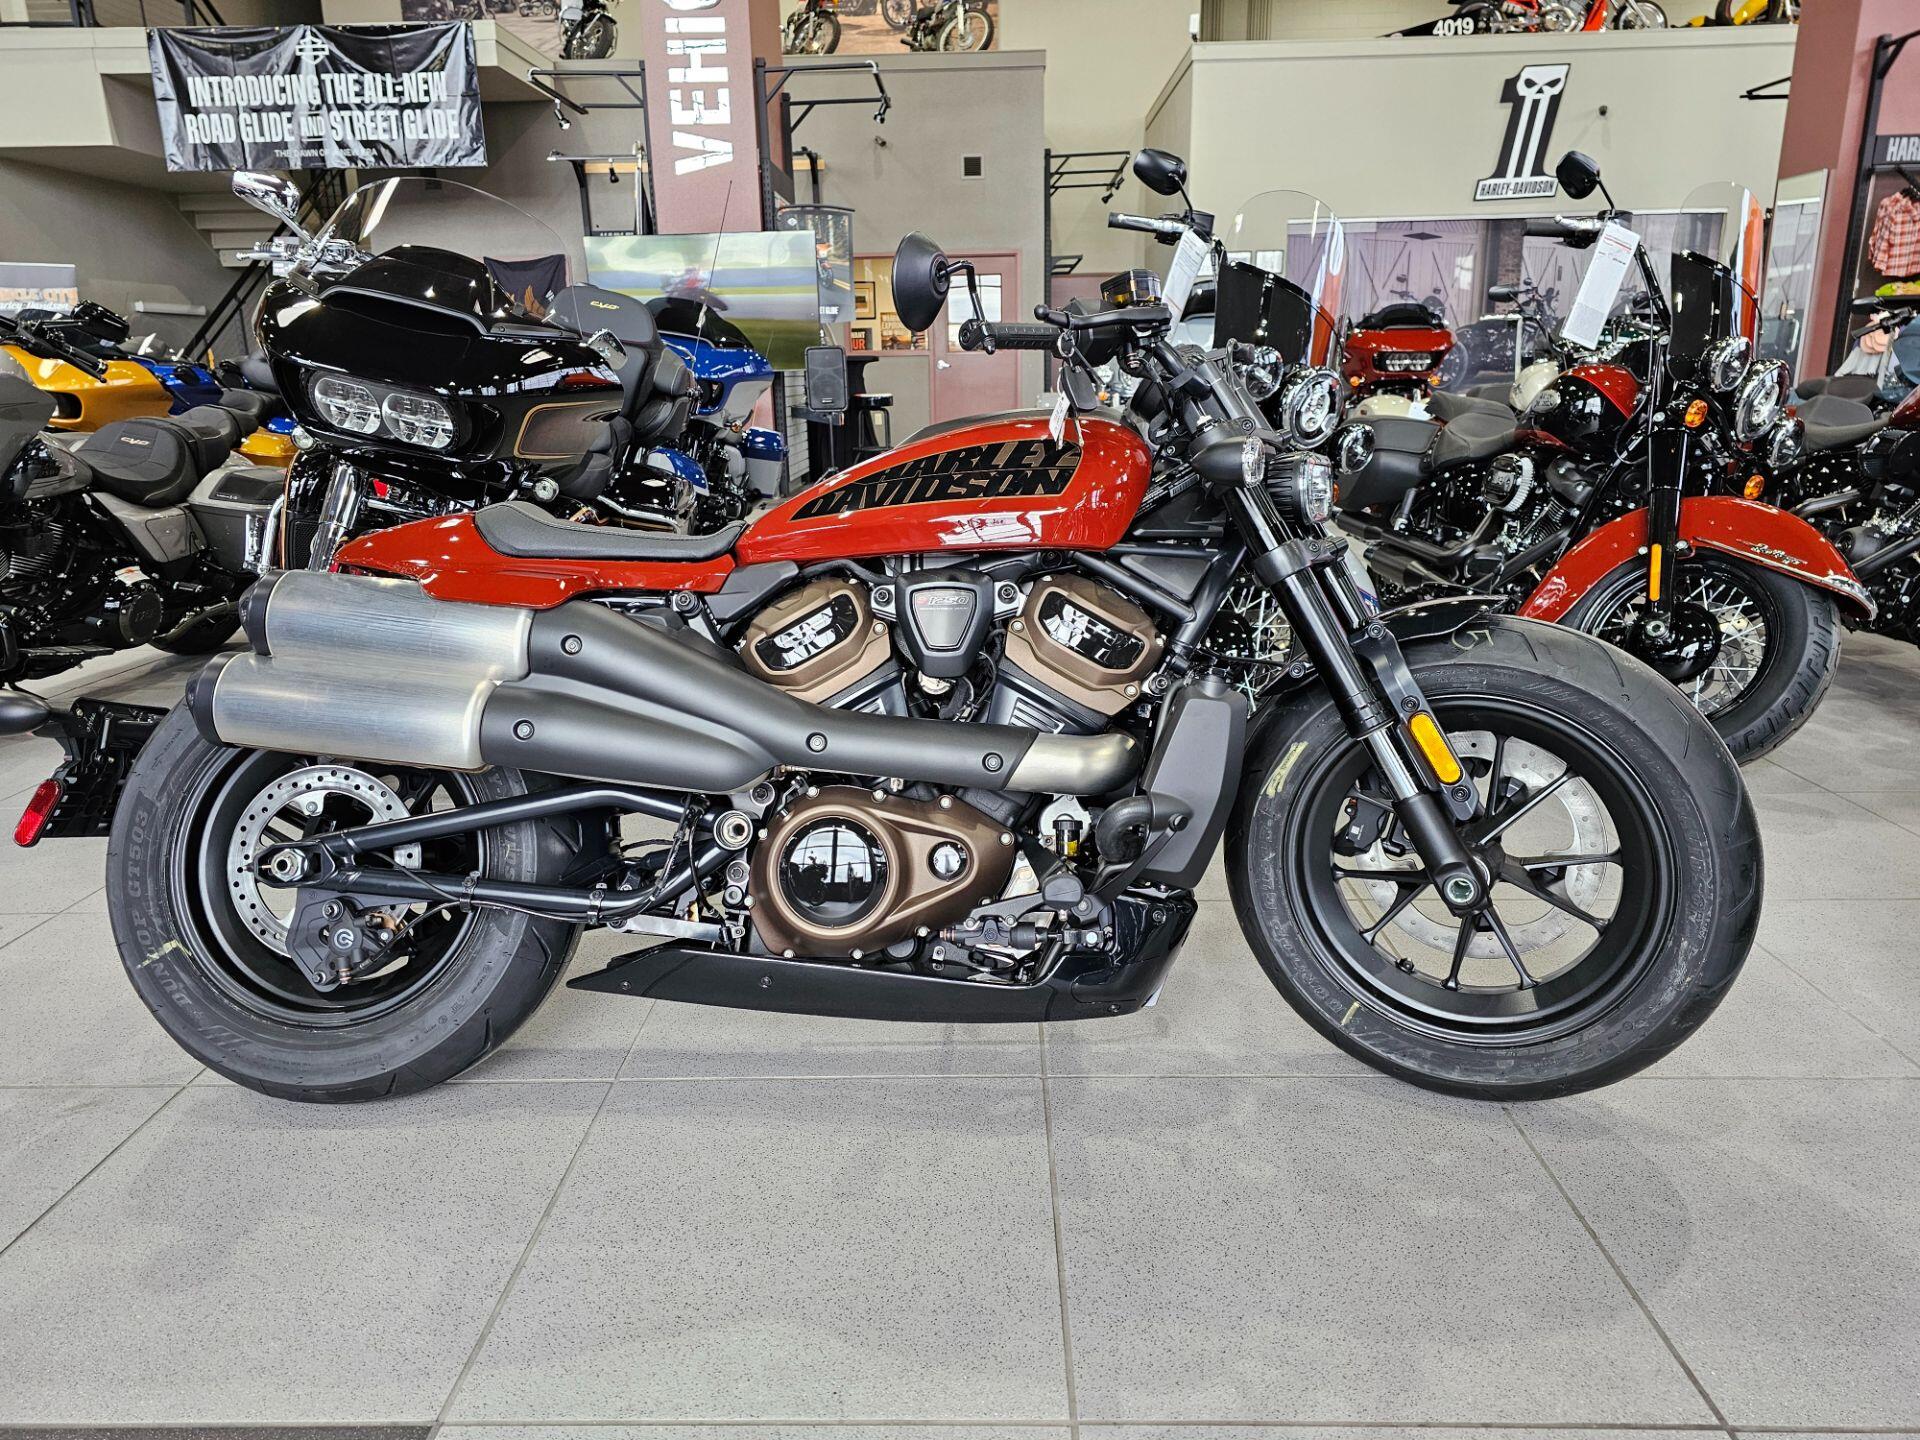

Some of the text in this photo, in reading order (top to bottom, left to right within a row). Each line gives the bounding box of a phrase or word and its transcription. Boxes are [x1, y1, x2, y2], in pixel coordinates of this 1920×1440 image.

[1432, 17, 1475, 37] 4019
[187, 71, 448, 108] INTRODUCING THE ALL-NEW
[184, 109, 460, 145] ROAD GLIDE AND STREET GLIDE
[1480, 180, 1556, 196] HARLEY-DAVIDSON
[862, 438, 1081, 482] HARLEY
[790, 467, 1075, 520] DAVIDSON
[127, 809, 150, 898] GT503
